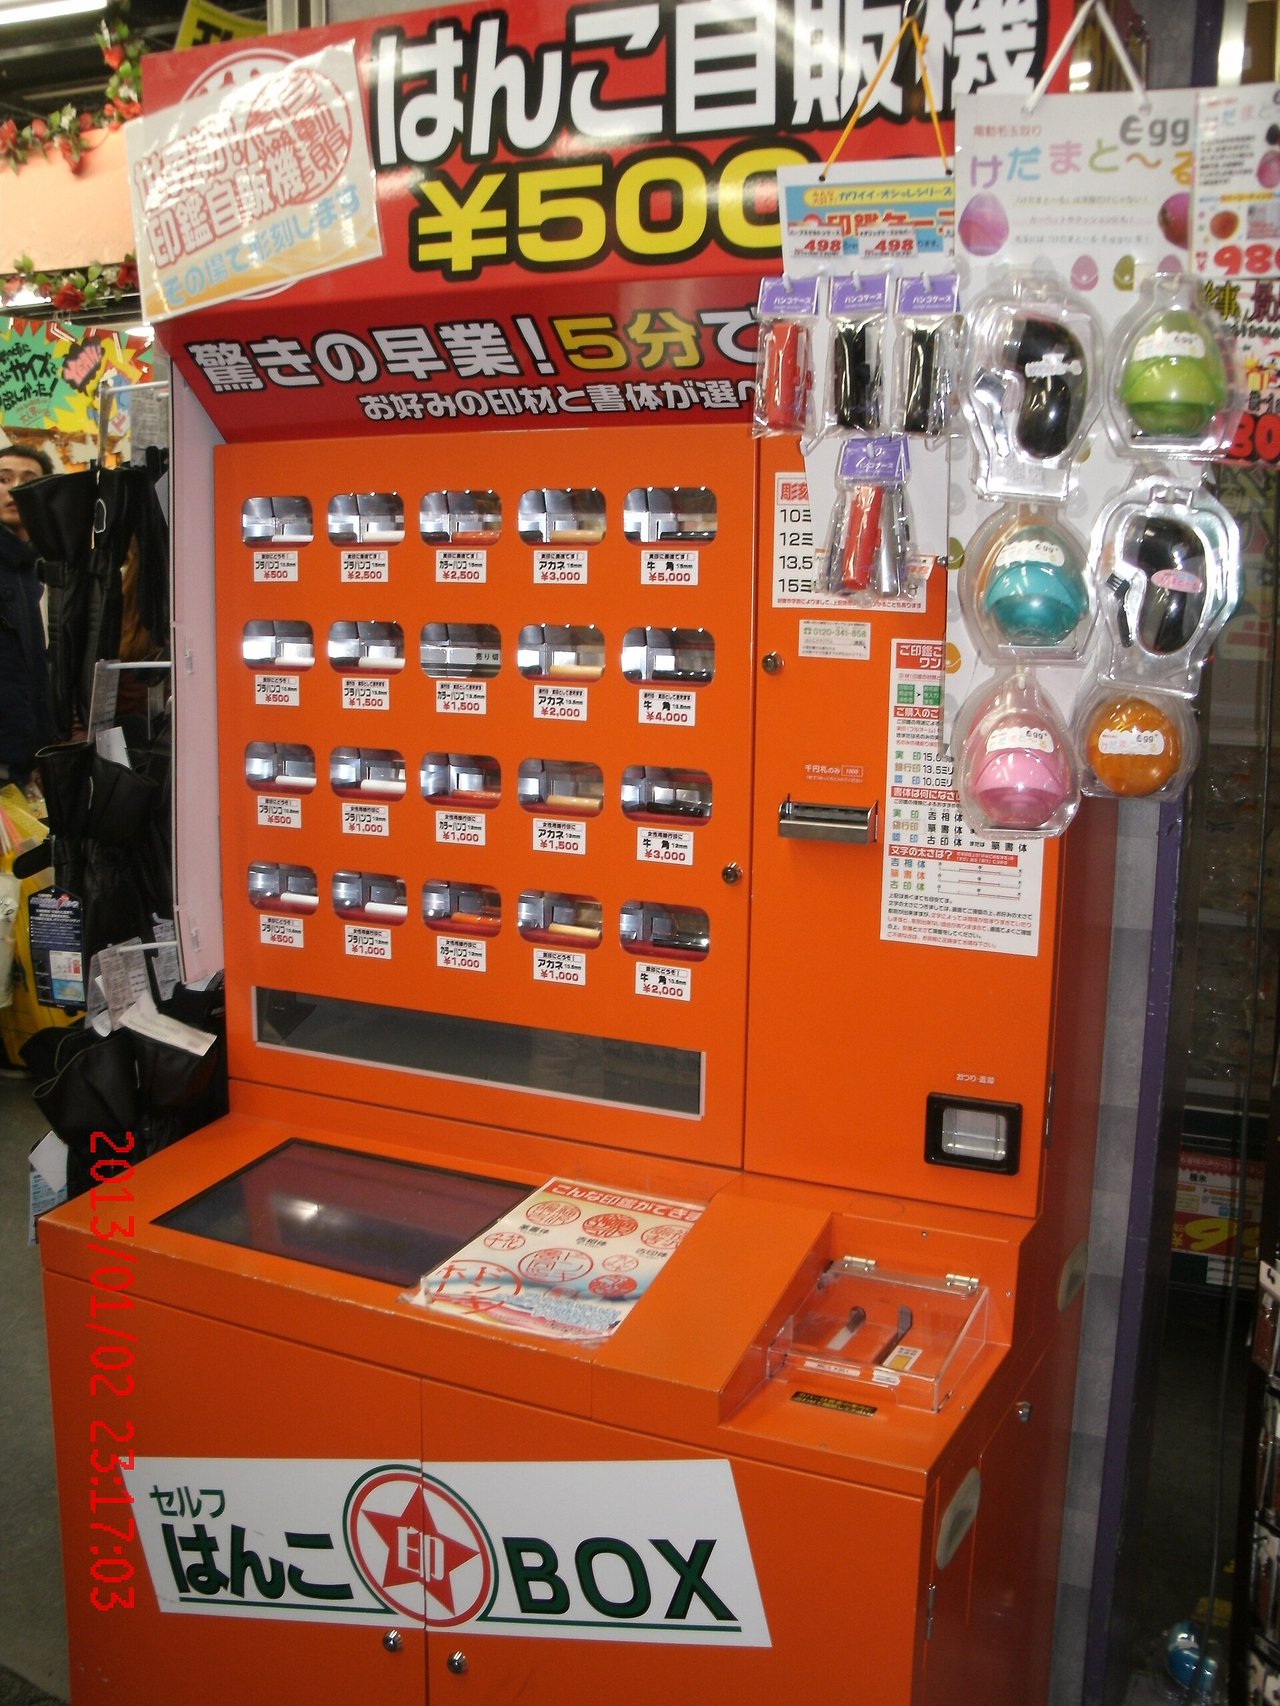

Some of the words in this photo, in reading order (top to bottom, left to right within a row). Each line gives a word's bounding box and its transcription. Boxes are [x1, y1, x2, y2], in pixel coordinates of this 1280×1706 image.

[164, 184, 361, 305] その場で彫刻します
[804, 239, 842, 252] 498
[874, 239, 914, 252] 498
[1213, 244, 1280, 276] 98
[255, 561, 279, 570] プラハンコ
[344, 561, 370, 570] プラハンコ
[440, 560, 467, 569] カラーハンコ
[539, 561, 565, 570] アカネ
[779, 555, 813, 570] 13.5
[264, 571, 288, 579] ¥500
[347, 571, 382, 580] ¥2,500
[442, 571, 480, 580] ¥2,500
[541, 572, 580, 581] ¥3,000
[649, 573, 690, 582] ¥5,000
[257, 684, 280, 693] プラハンコ
[344, 688, 371, 697] プラハンコ
[265, 694, 289, 702] ¥500
[438, 691, 464, 700] カラーハンコ
[538, 696, 564, 705] アカネ
[349, 698, 383, 707] ¥1,500
[443, 702, 480, 711] ¥1,500
[541, 707, 580, 717] ¥2,000
[646, 712, 688, 722] ¥4,000
[922, 765, 954, 775] 13.5ミリ
[922, 777, 953, 787] 10.0ミリ
[259, 805, 283, 814] プラハンコ
[267, 815, 291, 824] ¥500
[345, 812, 371, 822] プラハンコ
[349, 823, 383, 833] ¥1,000
[439, 821, 466, 831] カラーハンコ
[443, 831, 479, 842] ¥1,000
[538, 829, 563, 839] アカネ
[540, 840, 578, 851] ¥1,500
[645, 850, 685, 861] ¥3,000
[890, 845, 953, 860] 文字の太さは？
[262, 924, 285, 933] プラハンコ
[270, 935, 293, 944] ¥500
[348, 935, 373, 945] プラハンコ
[352, 945, 385, 956] ¥1,000
[440, 946, 467, 956] カラーハンコ
[444, 956, 480, 968] ¥1,000
[538, 959, 563, 970] アカネ
[541, 969, 578, 982] ¥1,000
[643, 983, 683, 997] ¥2,000
[149, 1484, 226, 1519] セルフ
[161, 1524, 355, 1600] はんこ
[501, 1536, 740, 1622] BOX
